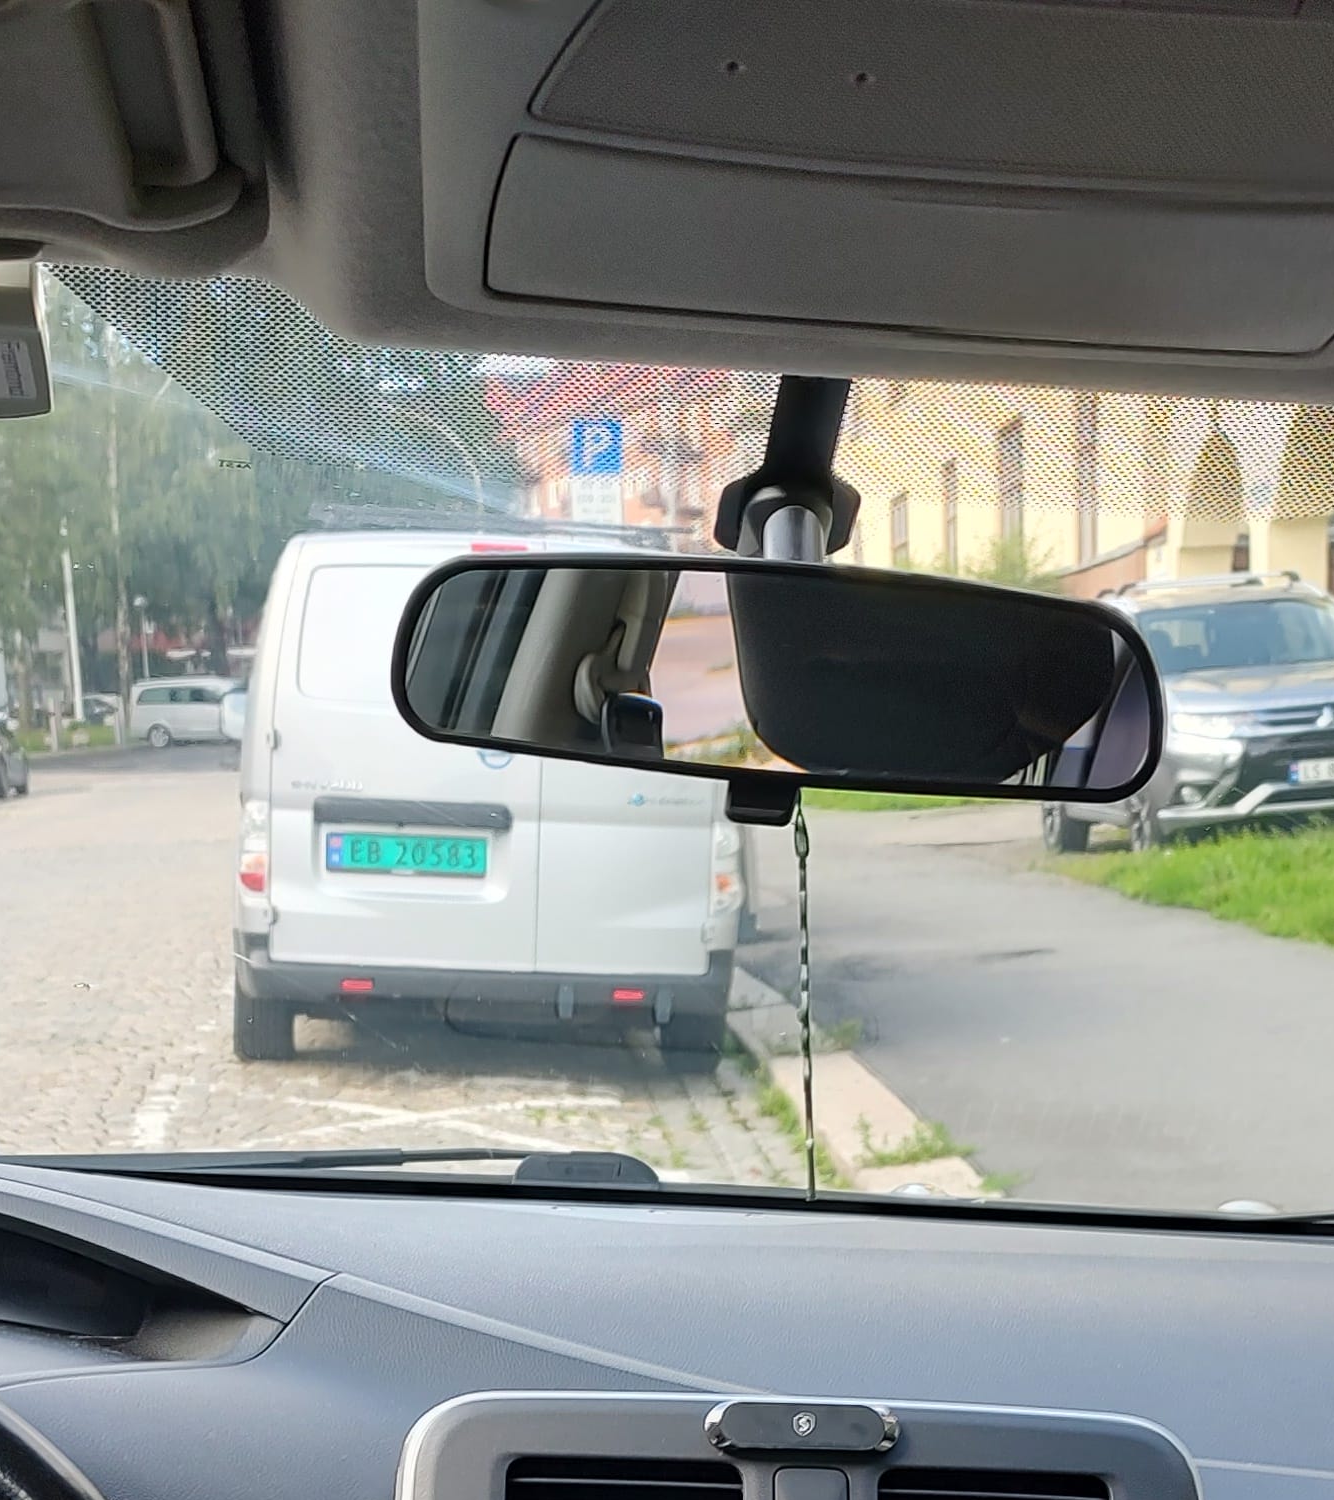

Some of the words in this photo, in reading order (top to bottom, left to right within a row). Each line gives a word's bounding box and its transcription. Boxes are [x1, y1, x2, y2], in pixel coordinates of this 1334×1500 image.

[580, 424, 609, 472] P
[350, 839, 381, 864] EB
[395, 841, 477, 868] 20583
